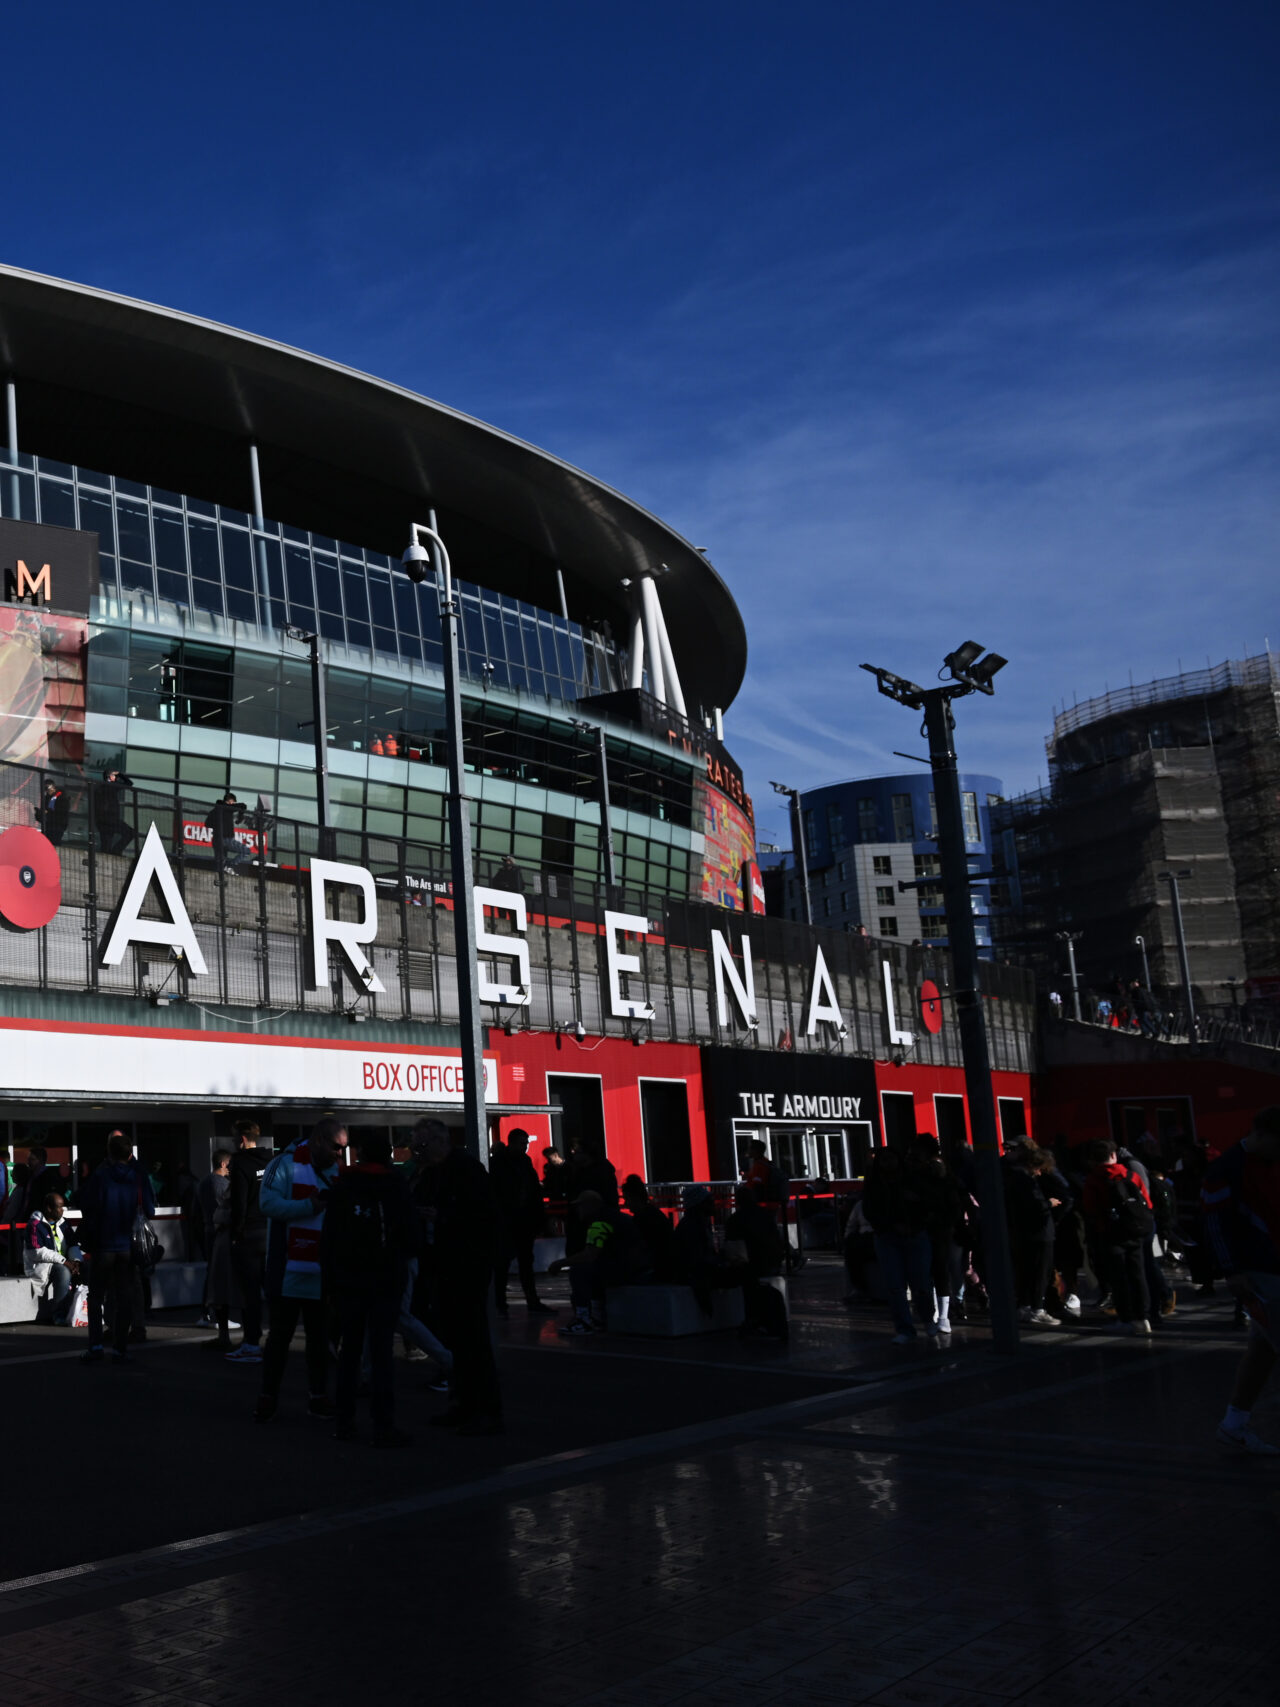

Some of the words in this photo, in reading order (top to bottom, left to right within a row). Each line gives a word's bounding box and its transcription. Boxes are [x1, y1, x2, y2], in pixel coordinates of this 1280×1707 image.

[405, 875, 419, 889] The
[102, 820, 913, 1046] ARSENAL
[363, 1061, 402, 1091] BOX
[406, 1063, 464, 1093] OFFICE
[738, 1092, 776, 1117] THE
[781, 1093, 862, 1120] ARMOURY
